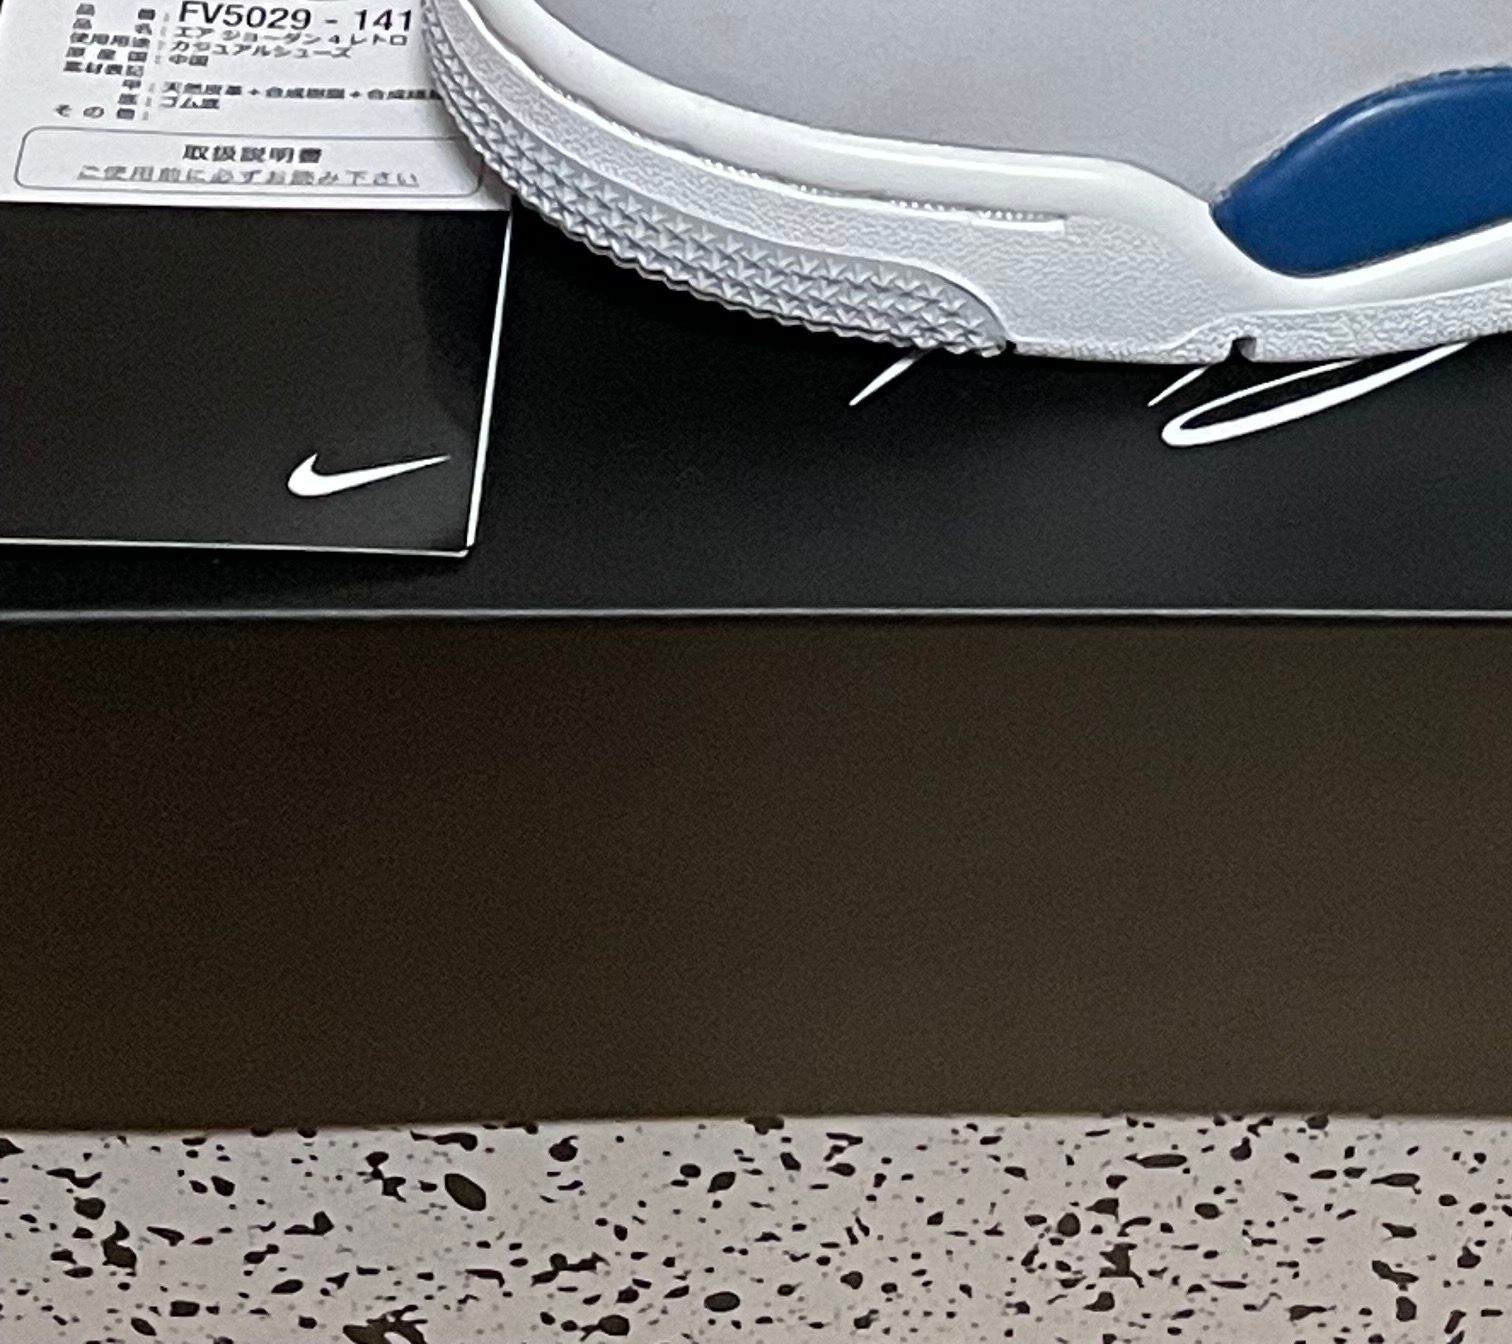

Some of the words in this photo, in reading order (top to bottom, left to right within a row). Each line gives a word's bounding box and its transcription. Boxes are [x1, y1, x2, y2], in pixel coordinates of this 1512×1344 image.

[179, 0, 311, 30] FV5029
[356, 9, 412, 32] 141
[349, 33, 407, 47] レトロ
